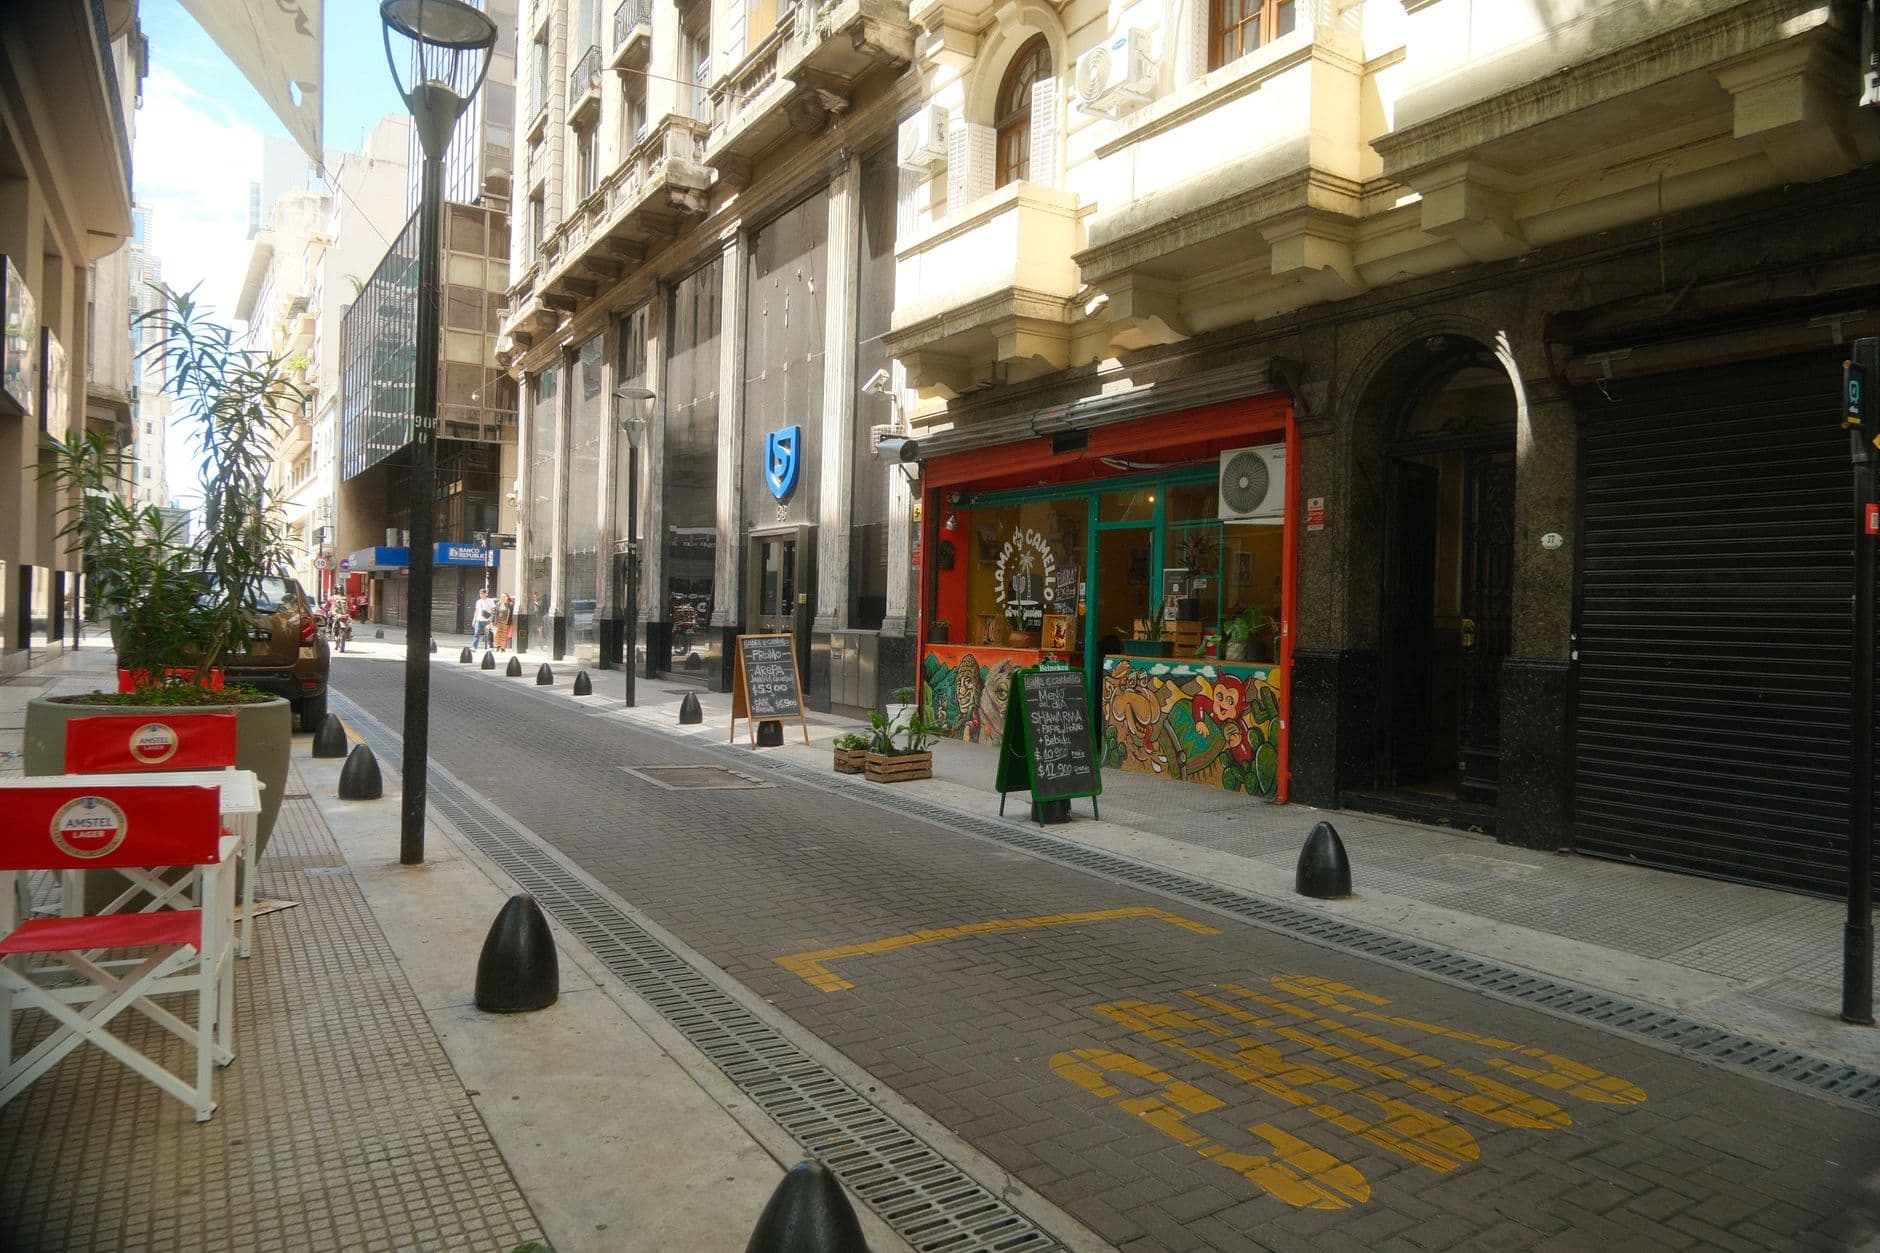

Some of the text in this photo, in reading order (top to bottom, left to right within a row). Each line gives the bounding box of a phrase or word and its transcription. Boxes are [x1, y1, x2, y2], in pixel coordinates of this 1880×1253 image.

[317, 559, 326, 567] 10
[994, 541, 1014, 605] LLAMA
[1025, 528, 1057, 602] CAMELLO
[1040, 664, 1069, 672] Heineken
[1031, 710, 1082, 724] SHAWARMA
[66, 817, 113, 829] AMSTEL
[72, 829, 105, 839] LAGER
